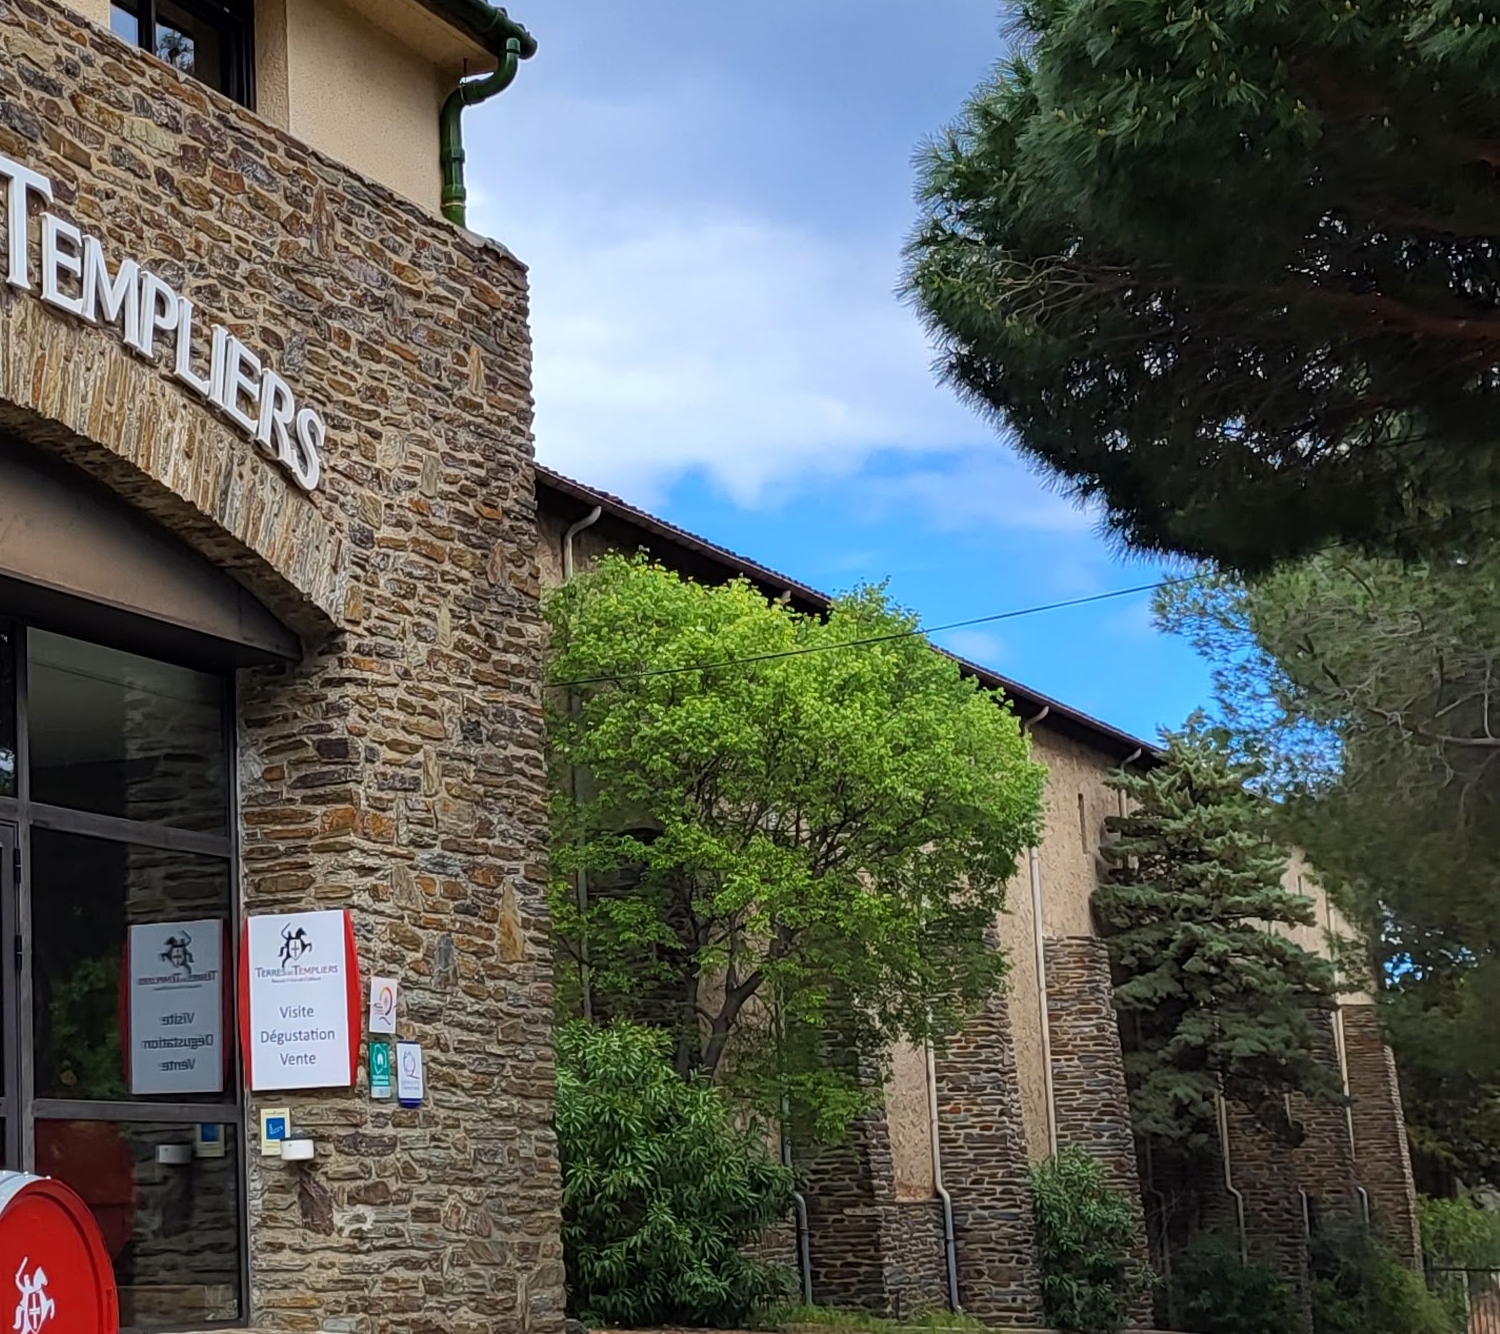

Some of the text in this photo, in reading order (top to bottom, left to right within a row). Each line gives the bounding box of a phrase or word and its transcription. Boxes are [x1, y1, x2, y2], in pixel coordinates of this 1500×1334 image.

[279, 1005, 315, 1019] Visite
[260, 1028, 336, 1046] Dégustation
[280, 1053, 317, 1066] Vente
